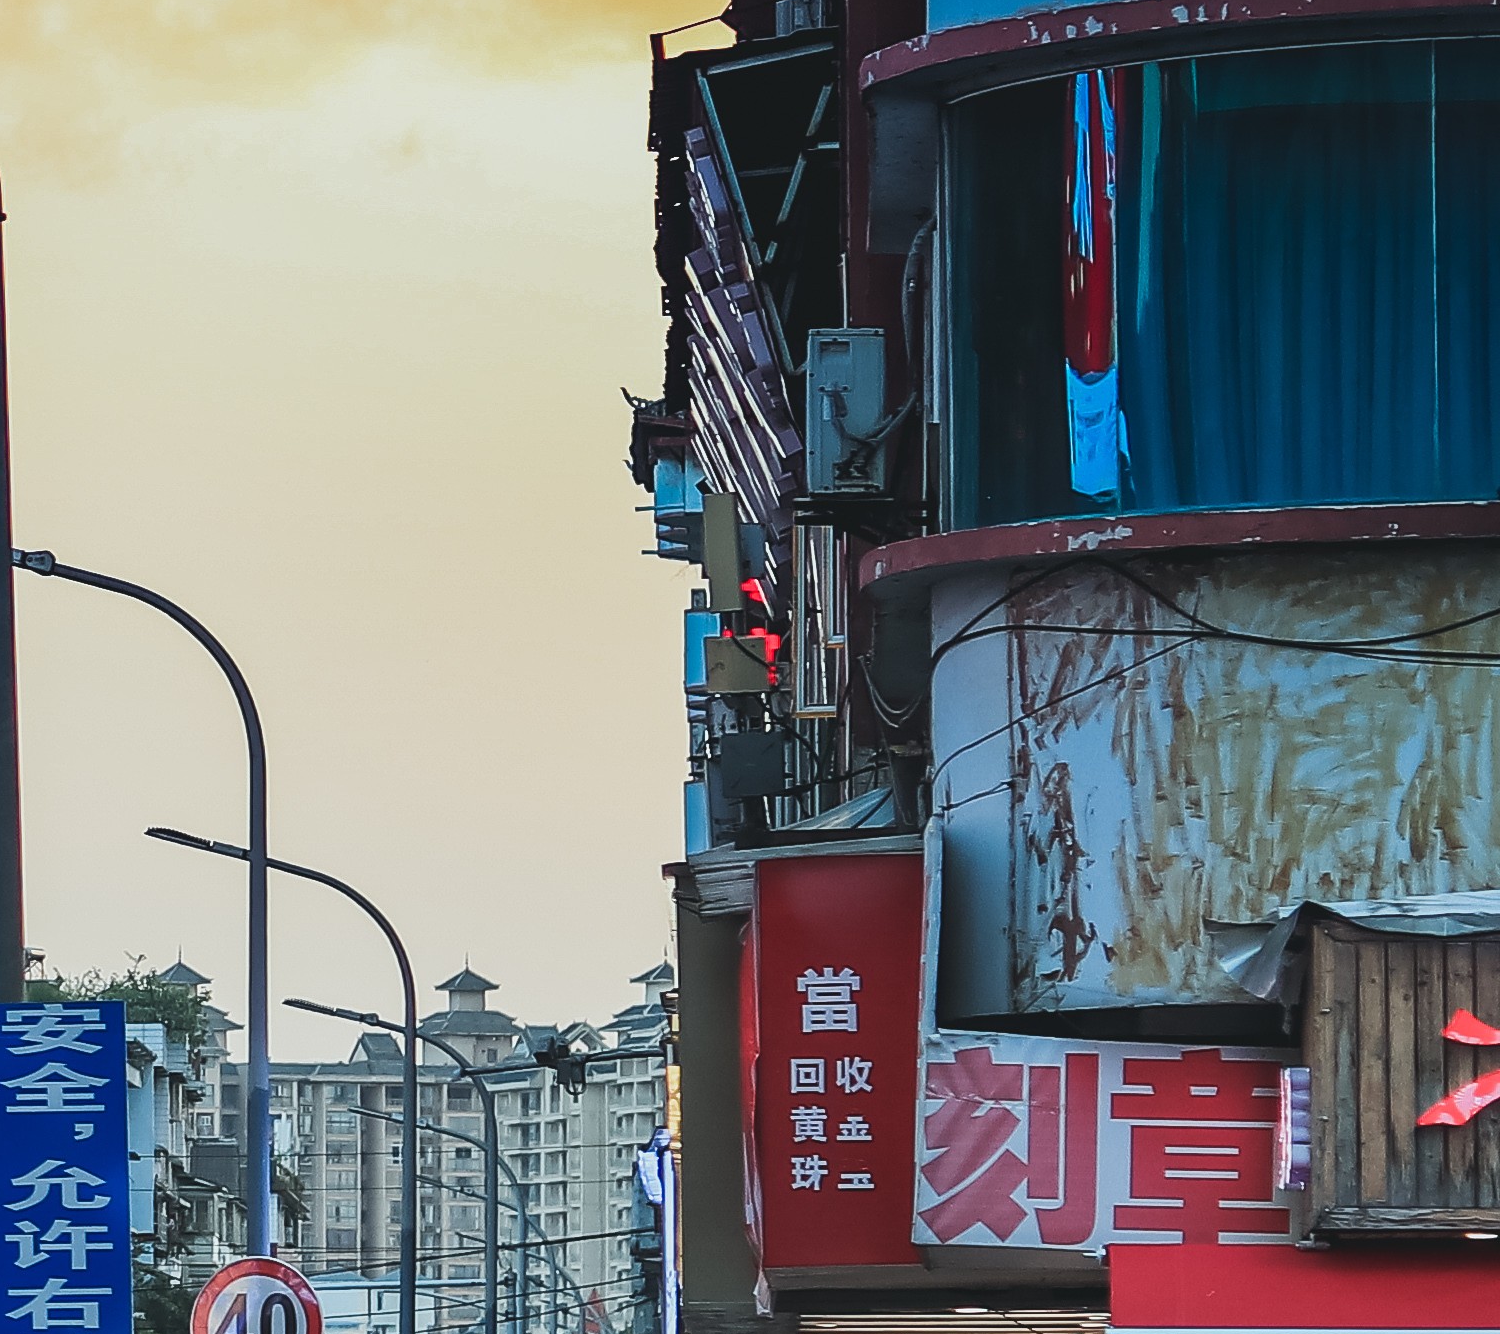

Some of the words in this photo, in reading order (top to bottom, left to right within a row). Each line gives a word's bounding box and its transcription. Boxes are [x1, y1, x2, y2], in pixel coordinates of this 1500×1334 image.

[795, 967, 862, 1034] 當
[790, 1056, 874, 1094] 回收
[917, 1047, 1294, 1245] 刻章
